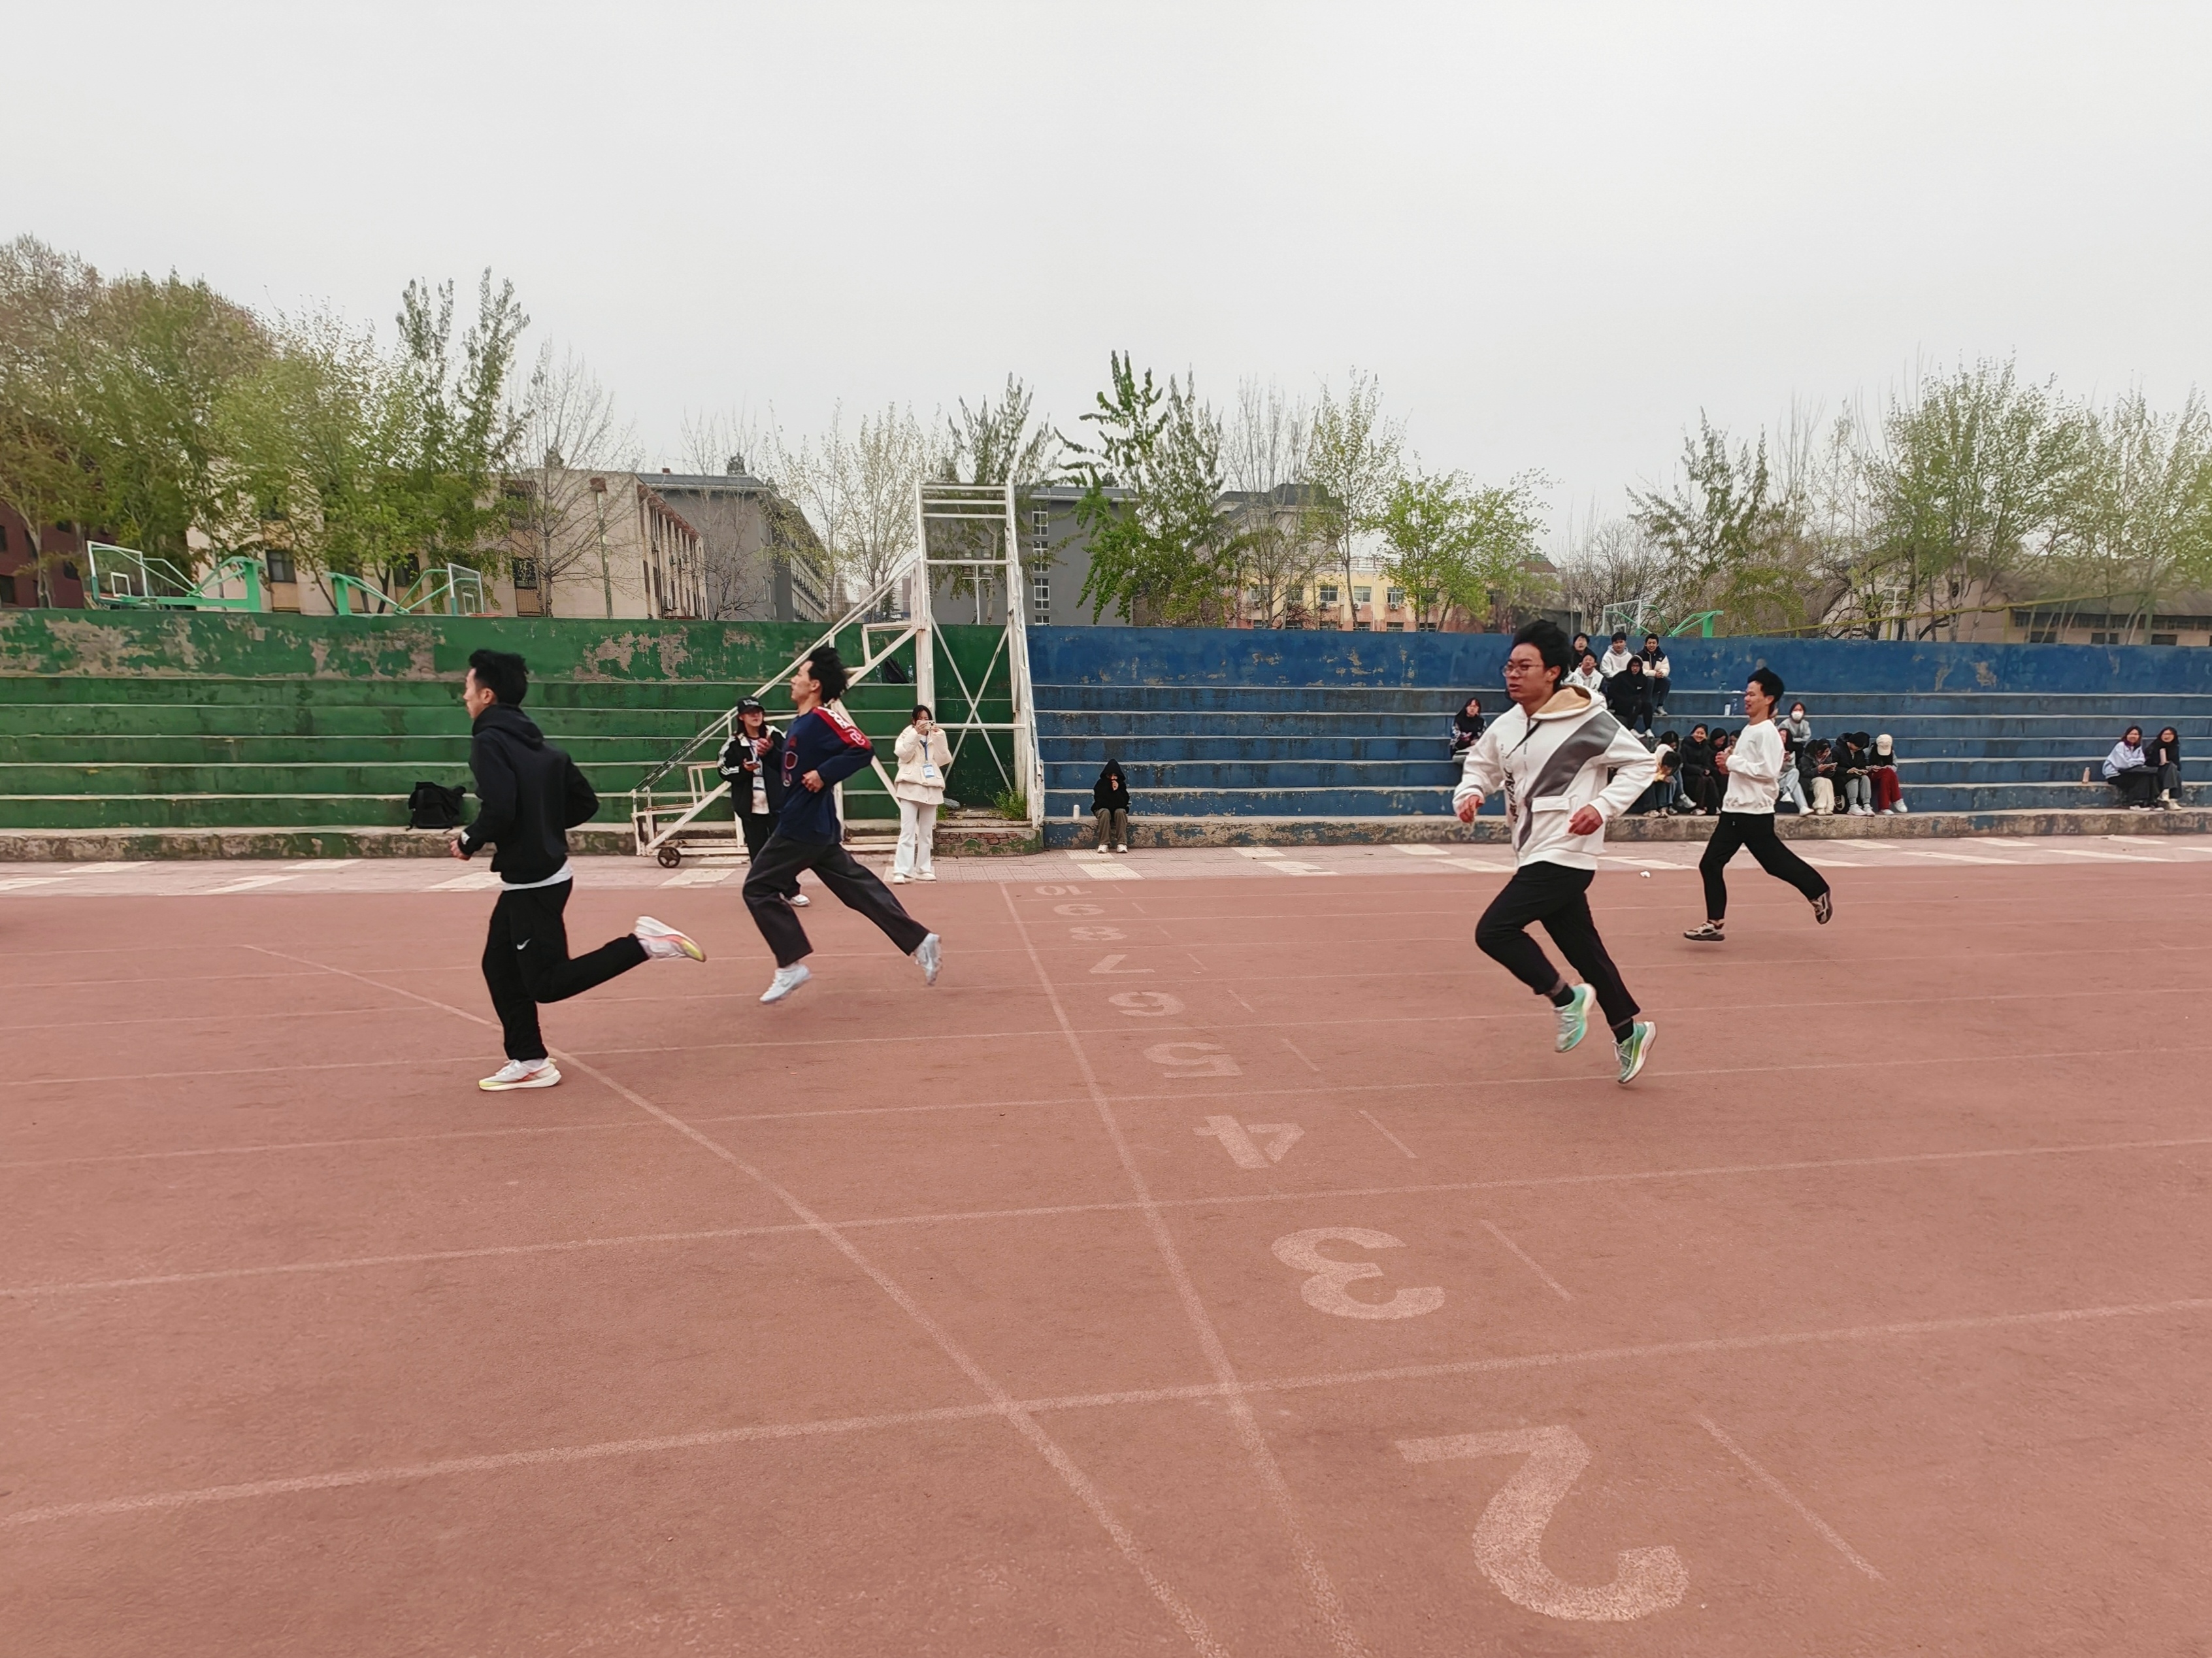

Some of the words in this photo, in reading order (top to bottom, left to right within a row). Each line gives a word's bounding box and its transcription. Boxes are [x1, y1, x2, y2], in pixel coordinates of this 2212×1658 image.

[1034, 884, 1092, 896] 10
[1070, 925, 1127, 941] 8
[1089, 954, 1155, 974] 7
[1143, 1041, 1242, 1078] 5
[1193, 1114, 1306, 1169] 4
[1271, 1226, 1445, 1320] 3
[1394, 1424, 1689, 1621] 2
